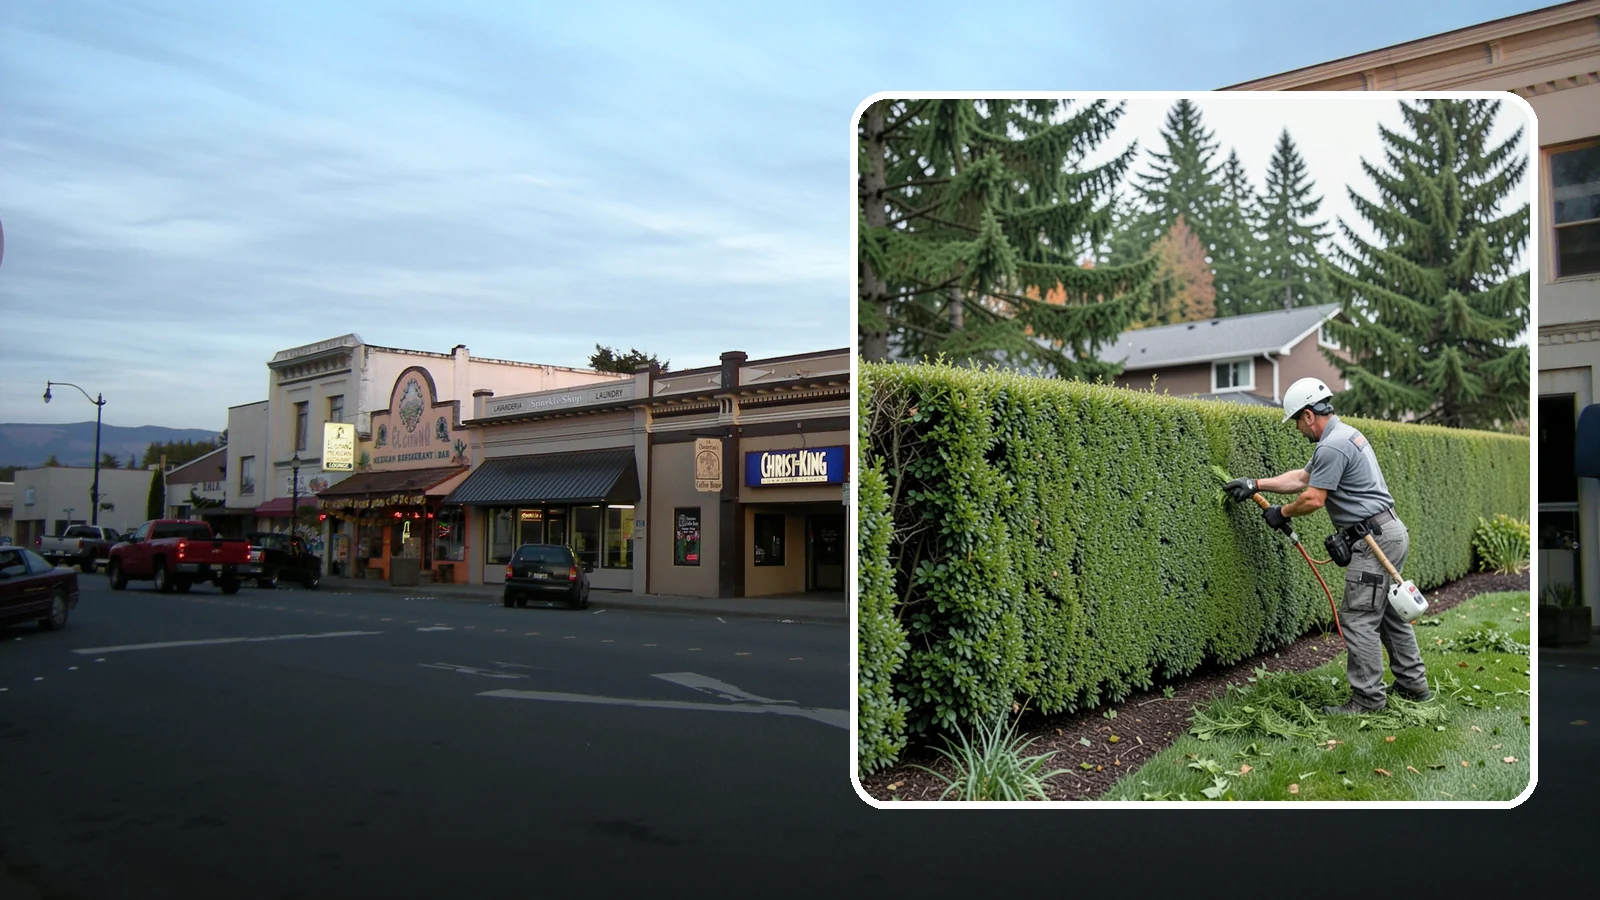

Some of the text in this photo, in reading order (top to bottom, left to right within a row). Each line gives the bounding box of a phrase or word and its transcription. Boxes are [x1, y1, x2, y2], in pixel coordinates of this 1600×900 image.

[596, 388, 624, 400] LAUNDRY
[493, 401, 522, 413] LAVANDERIA
[530, 394, 583, 409] Sparkle Shop
[374, 455, 396, 464] MEXICAN
[398, 452, 433, 462] RESTAURANT
[438, 450, 450, 459] BAR
